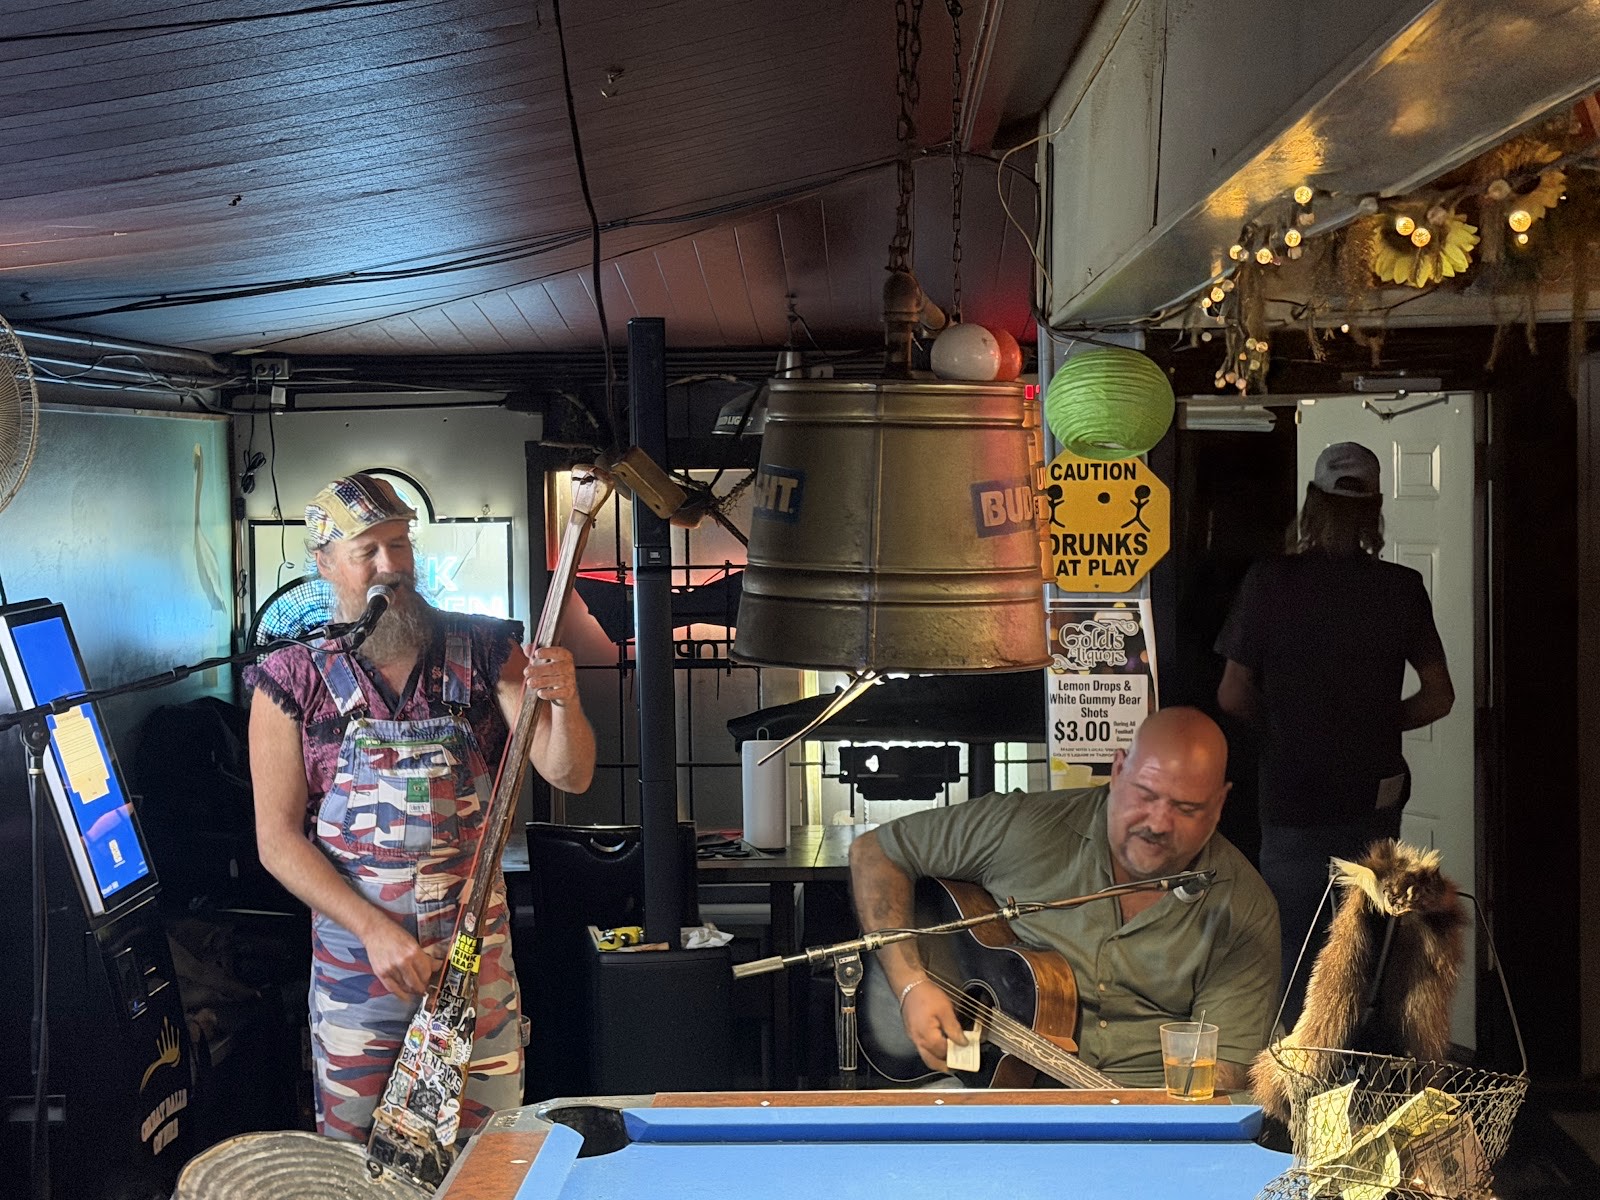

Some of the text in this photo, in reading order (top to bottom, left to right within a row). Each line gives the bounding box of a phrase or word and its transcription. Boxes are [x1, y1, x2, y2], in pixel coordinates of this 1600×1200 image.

[1050, 463, 1137, 481] CAUTION
[1050, 533, 1149, 556] DRUNKS
[1056, 559, 1140, 577] AT PLAY
[1059, 622, 1125, 650] Gold's
[1058, 680, 1132, 693] Lemon Drops &
[1049, 693, 1142, 706] White Gummy Bear
[1081, 707, 1109, 718] Shots
[1054, 719, 1111, 743] $3.00
